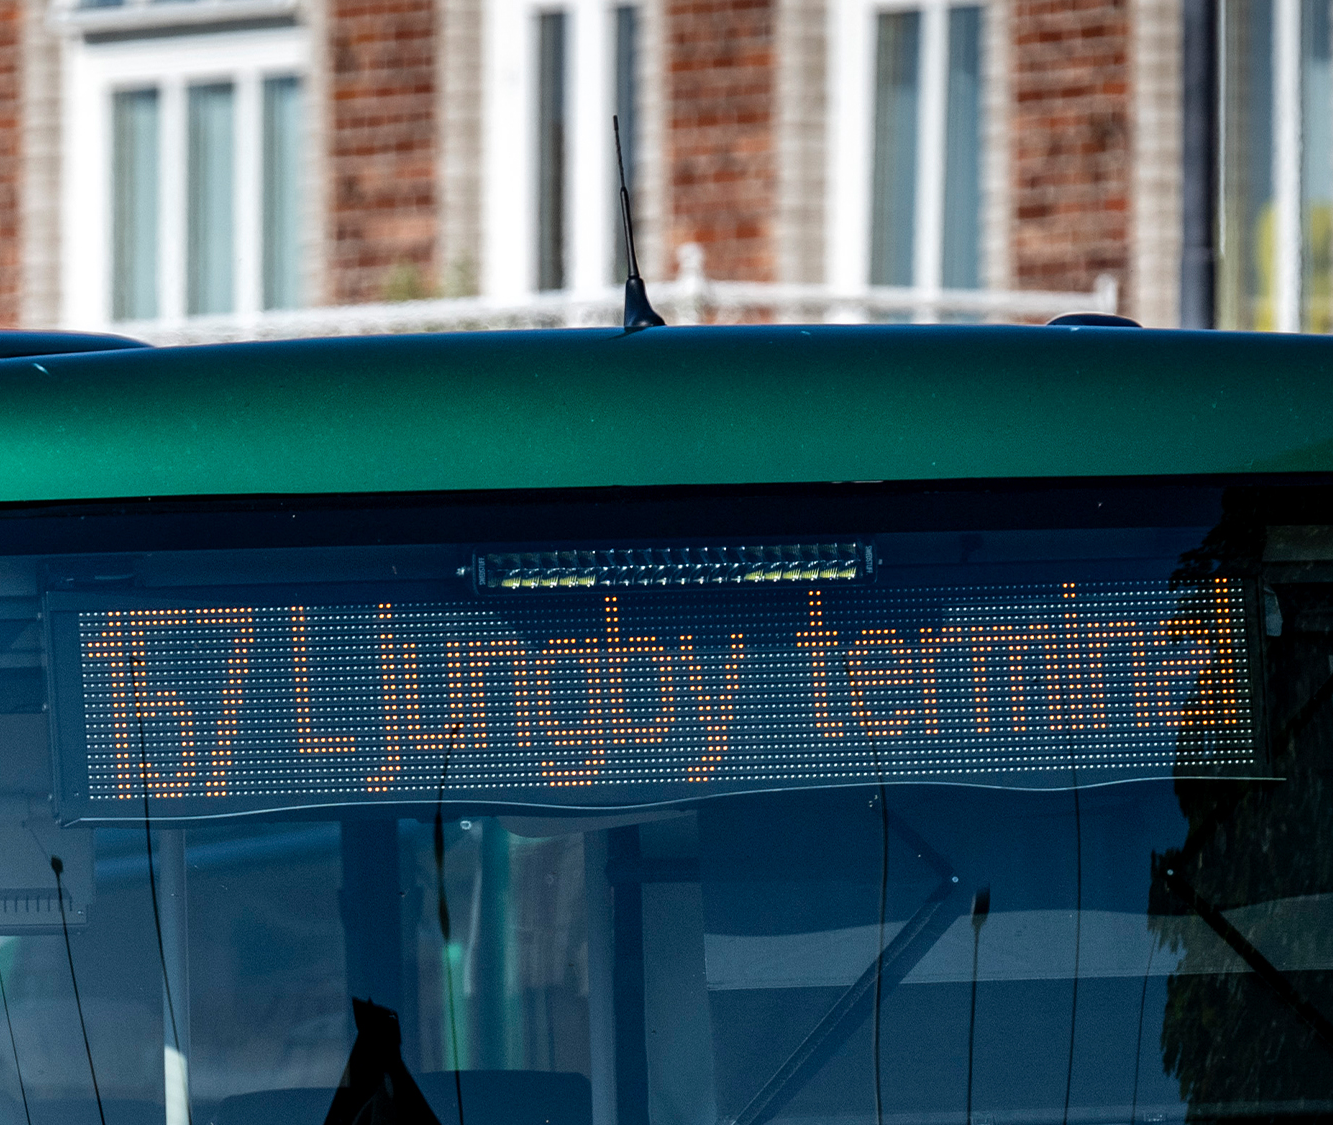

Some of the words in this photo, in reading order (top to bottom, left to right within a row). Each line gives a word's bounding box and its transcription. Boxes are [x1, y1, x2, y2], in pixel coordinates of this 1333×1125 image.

[87, 608, 253, 799] 157
[290, 596, 744, 792] Ljungby
[796, 578, 1237, 738] terminal
